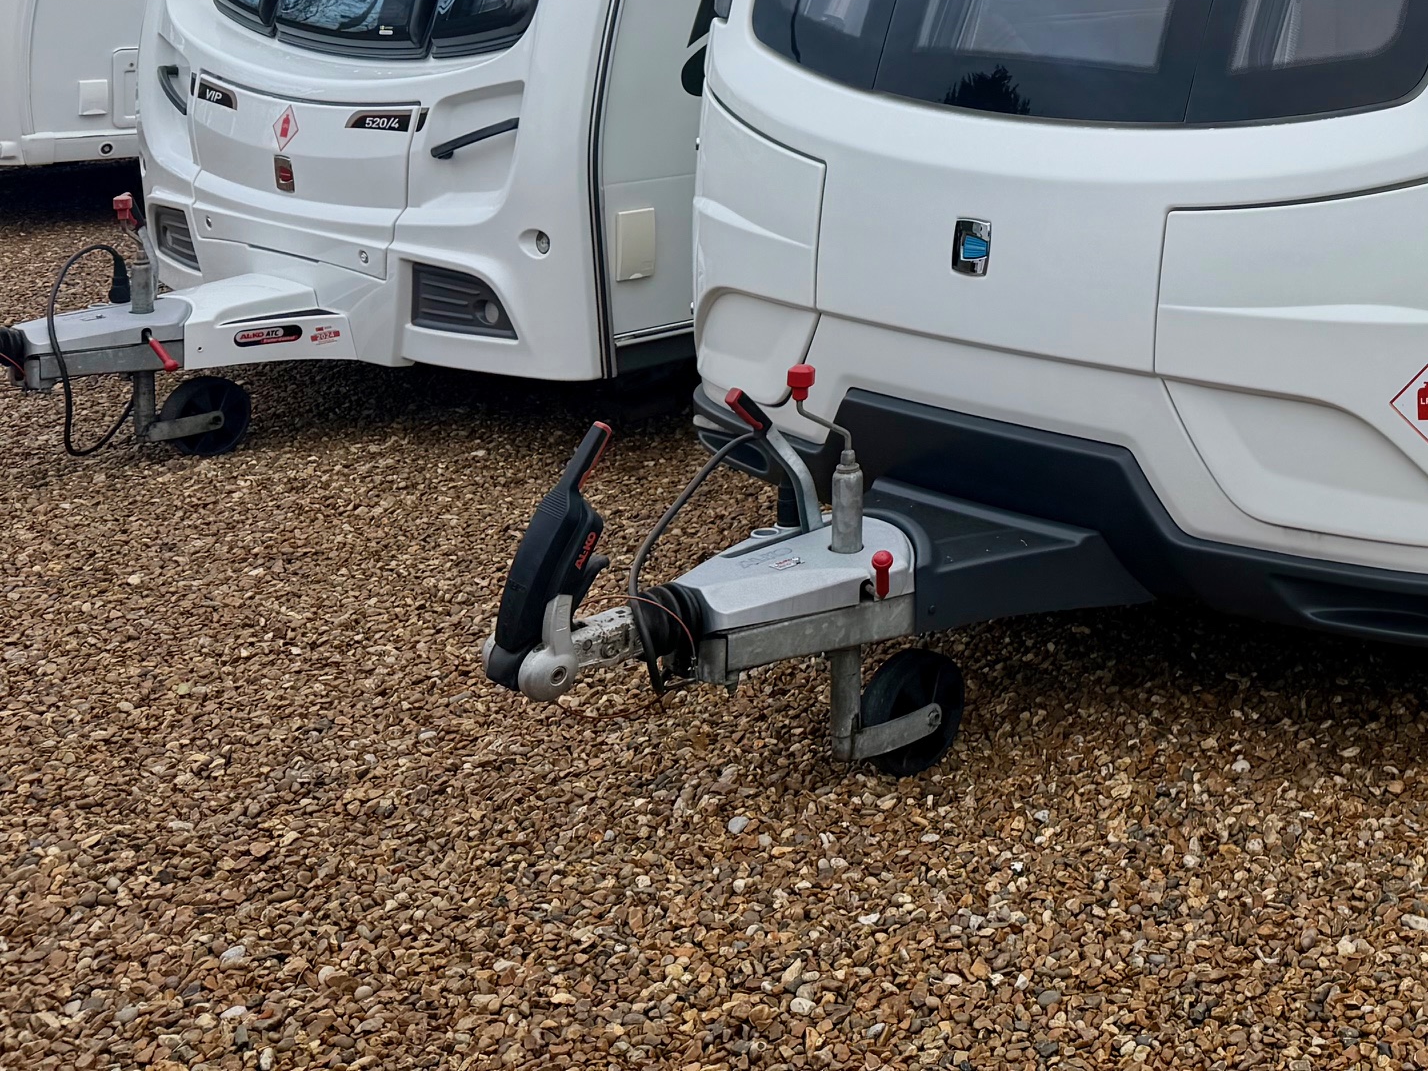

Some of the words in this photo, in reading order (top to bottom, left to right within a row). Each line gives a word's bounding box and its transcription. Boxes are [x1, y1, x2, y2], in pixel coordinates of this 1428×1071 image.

[205, 88, 223, 102] VIP
[364, 116, 400, 129] 520/4
[265, 329, 280, 338] ATC
